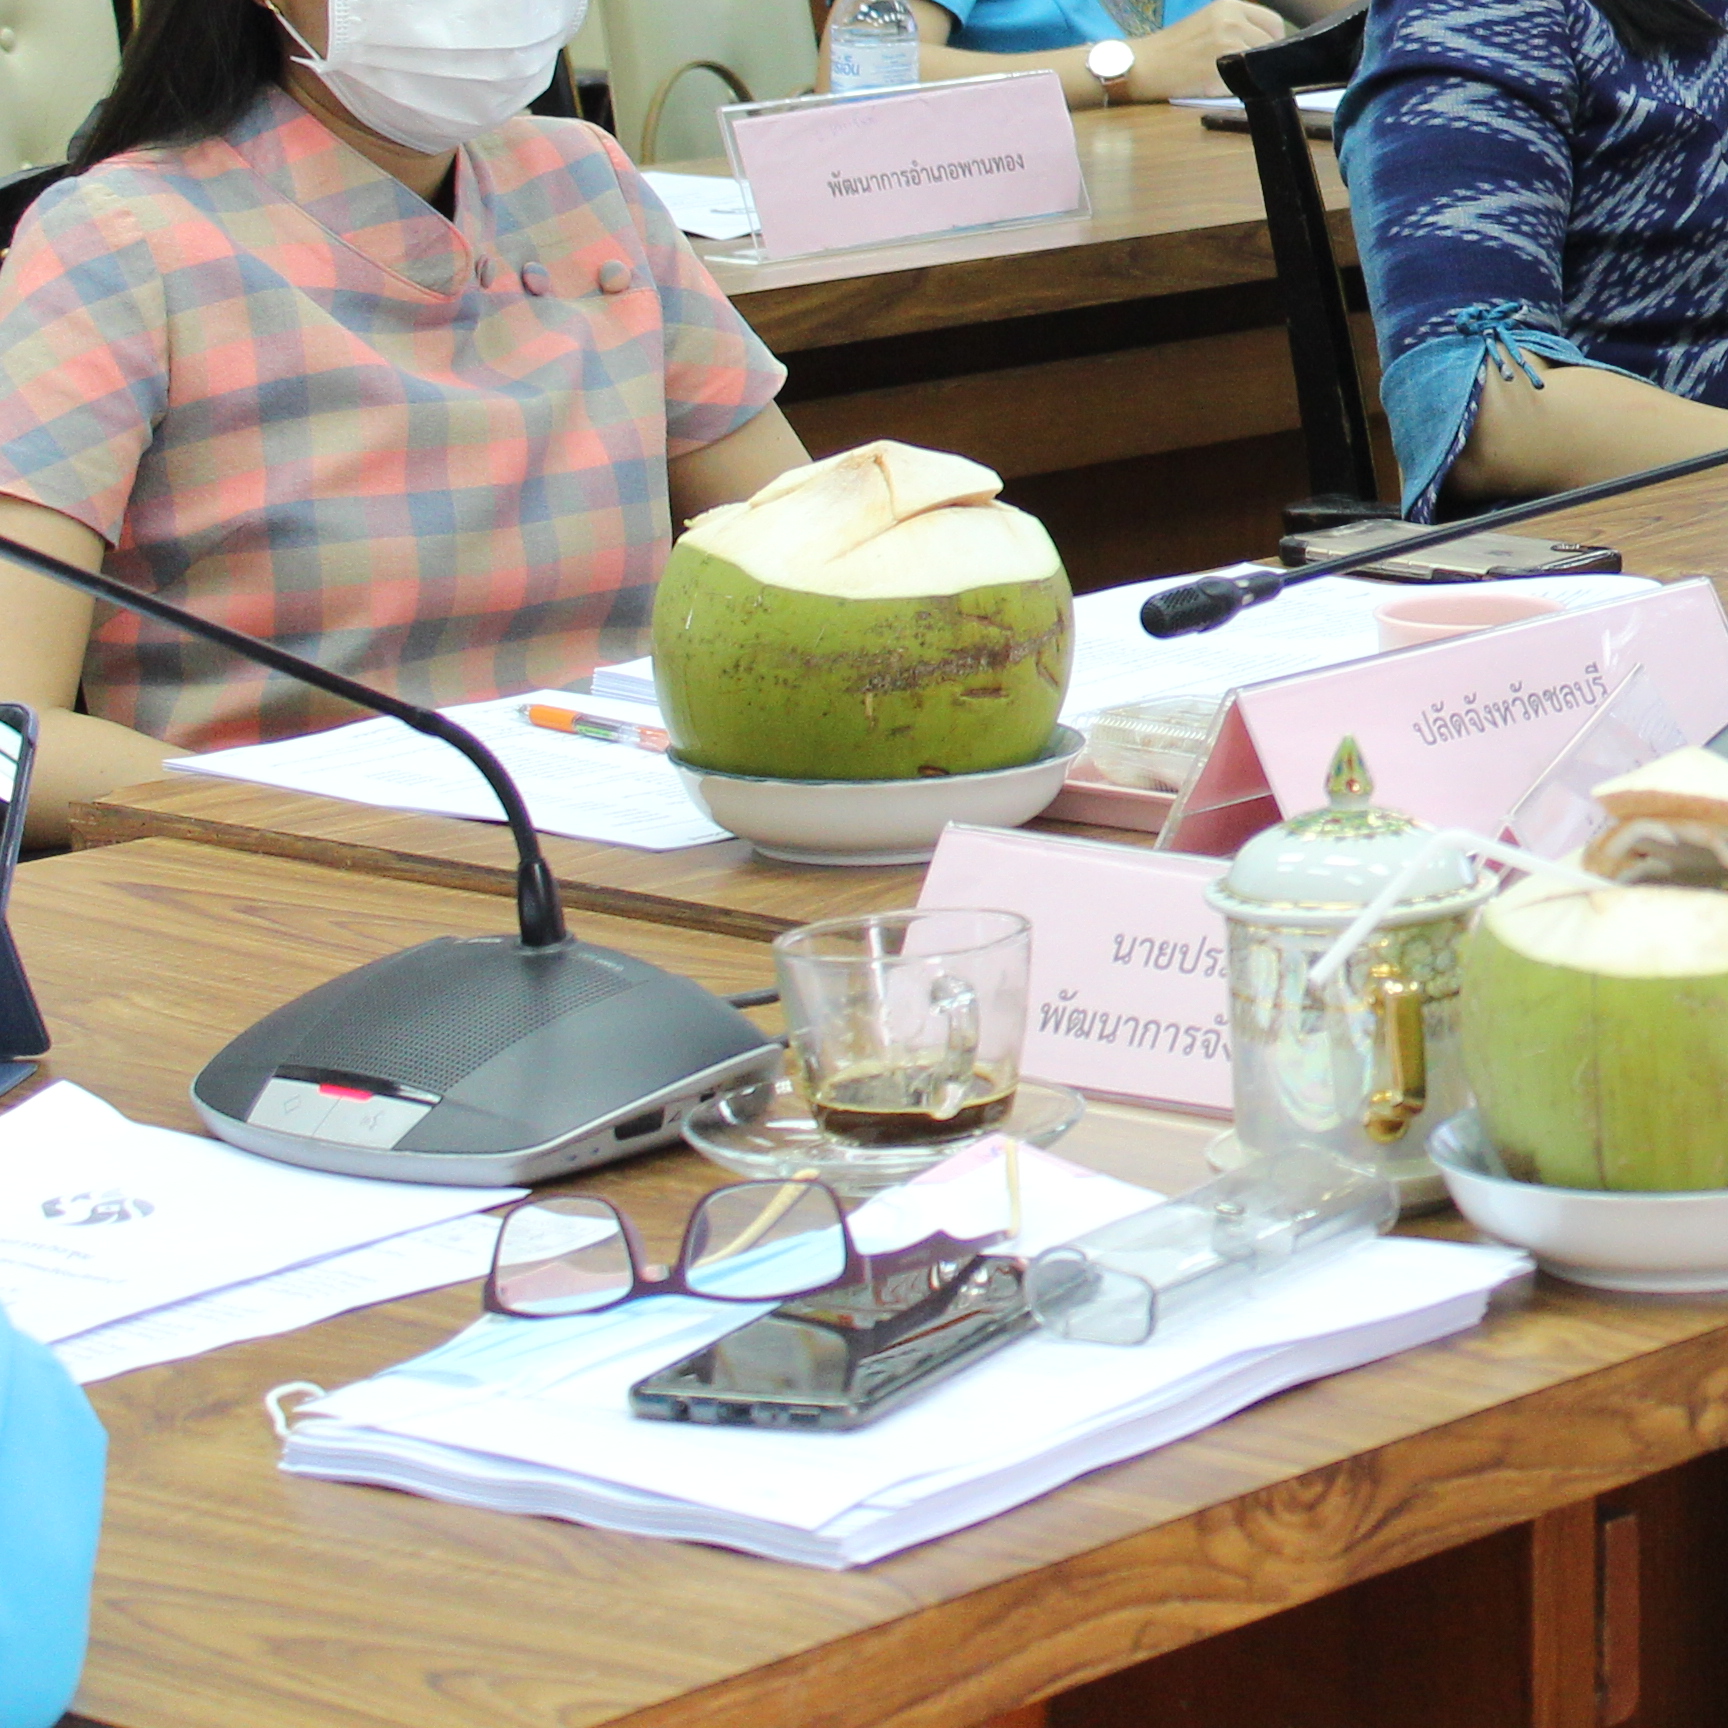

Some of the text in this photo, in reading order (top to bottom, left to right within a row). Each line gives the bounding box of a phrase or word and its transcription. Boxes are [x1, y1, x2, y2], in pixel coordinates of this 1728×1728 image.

[828, 151, 1026, 200] พัฒนาการอำเภอพานทอง
[1413, 661, 1608, 746] ปลัดจังหวัดชลบุรี
